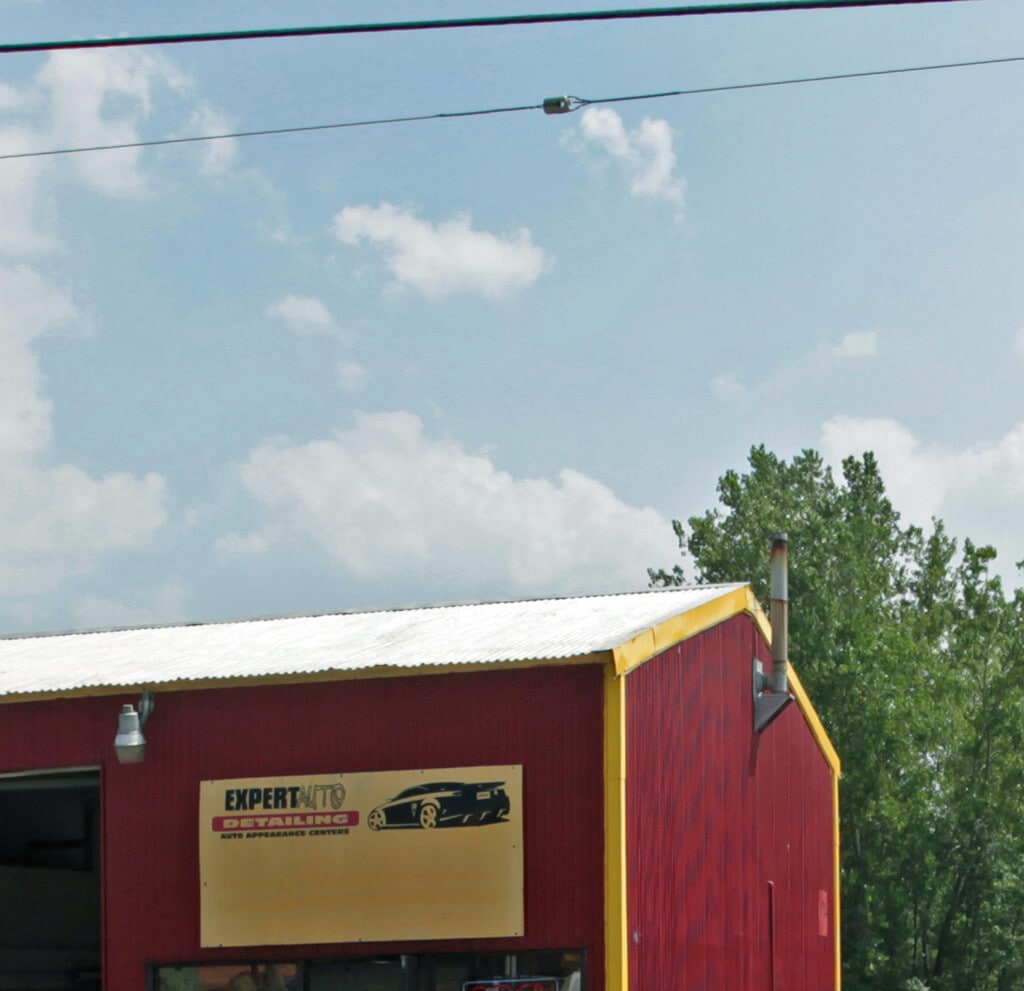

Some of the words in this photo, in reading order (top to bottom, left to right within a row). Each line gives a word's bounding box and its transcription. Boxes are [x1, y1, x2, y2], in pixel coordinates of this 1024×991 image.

[222, 814, 349, 829] DETAILING
[245, 830, 306, 839] APPEARANCE
[308, 828, 350, 836] CENTERS
